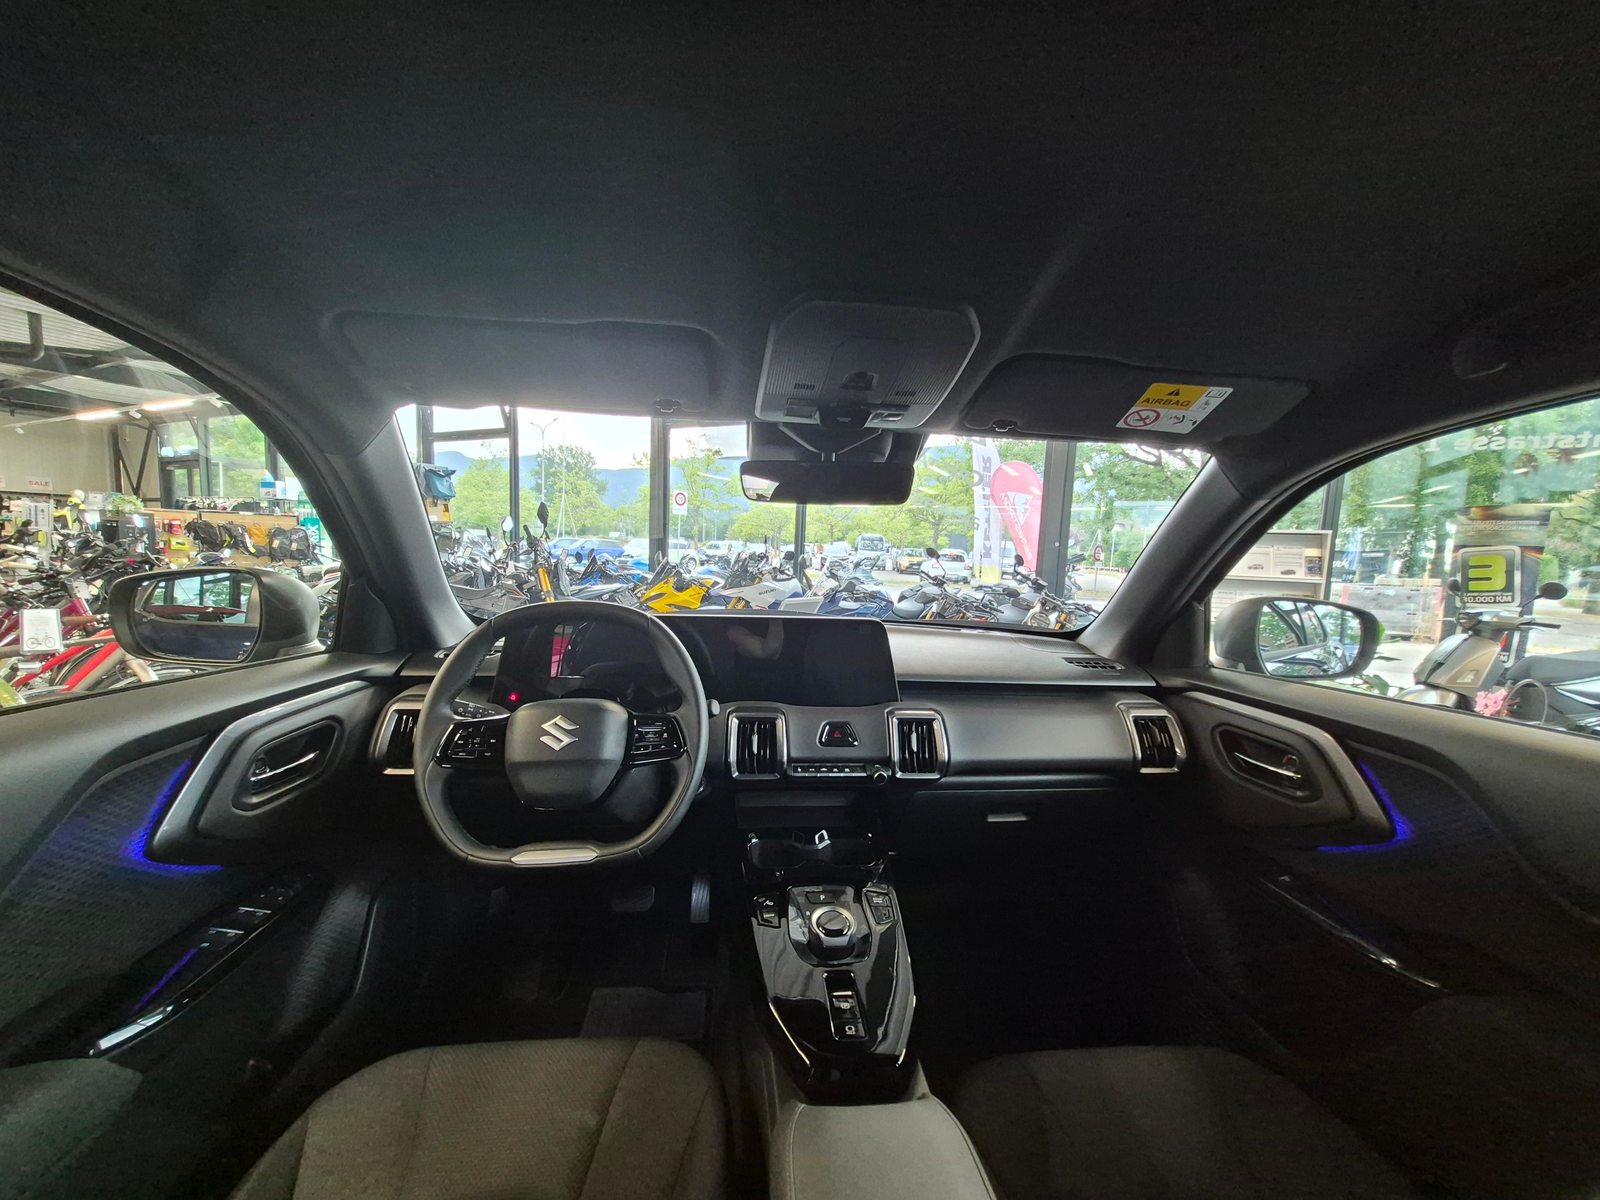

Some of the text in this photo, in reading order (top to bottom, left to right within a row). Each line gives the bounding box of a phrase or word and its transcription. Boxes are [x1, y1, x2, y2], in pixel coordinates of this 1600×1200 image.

[1141, 398, 1192, 407] AIRBAG
[1468, 554, 1507, 591] 3
[1496, 595, 1512, 603] KM
